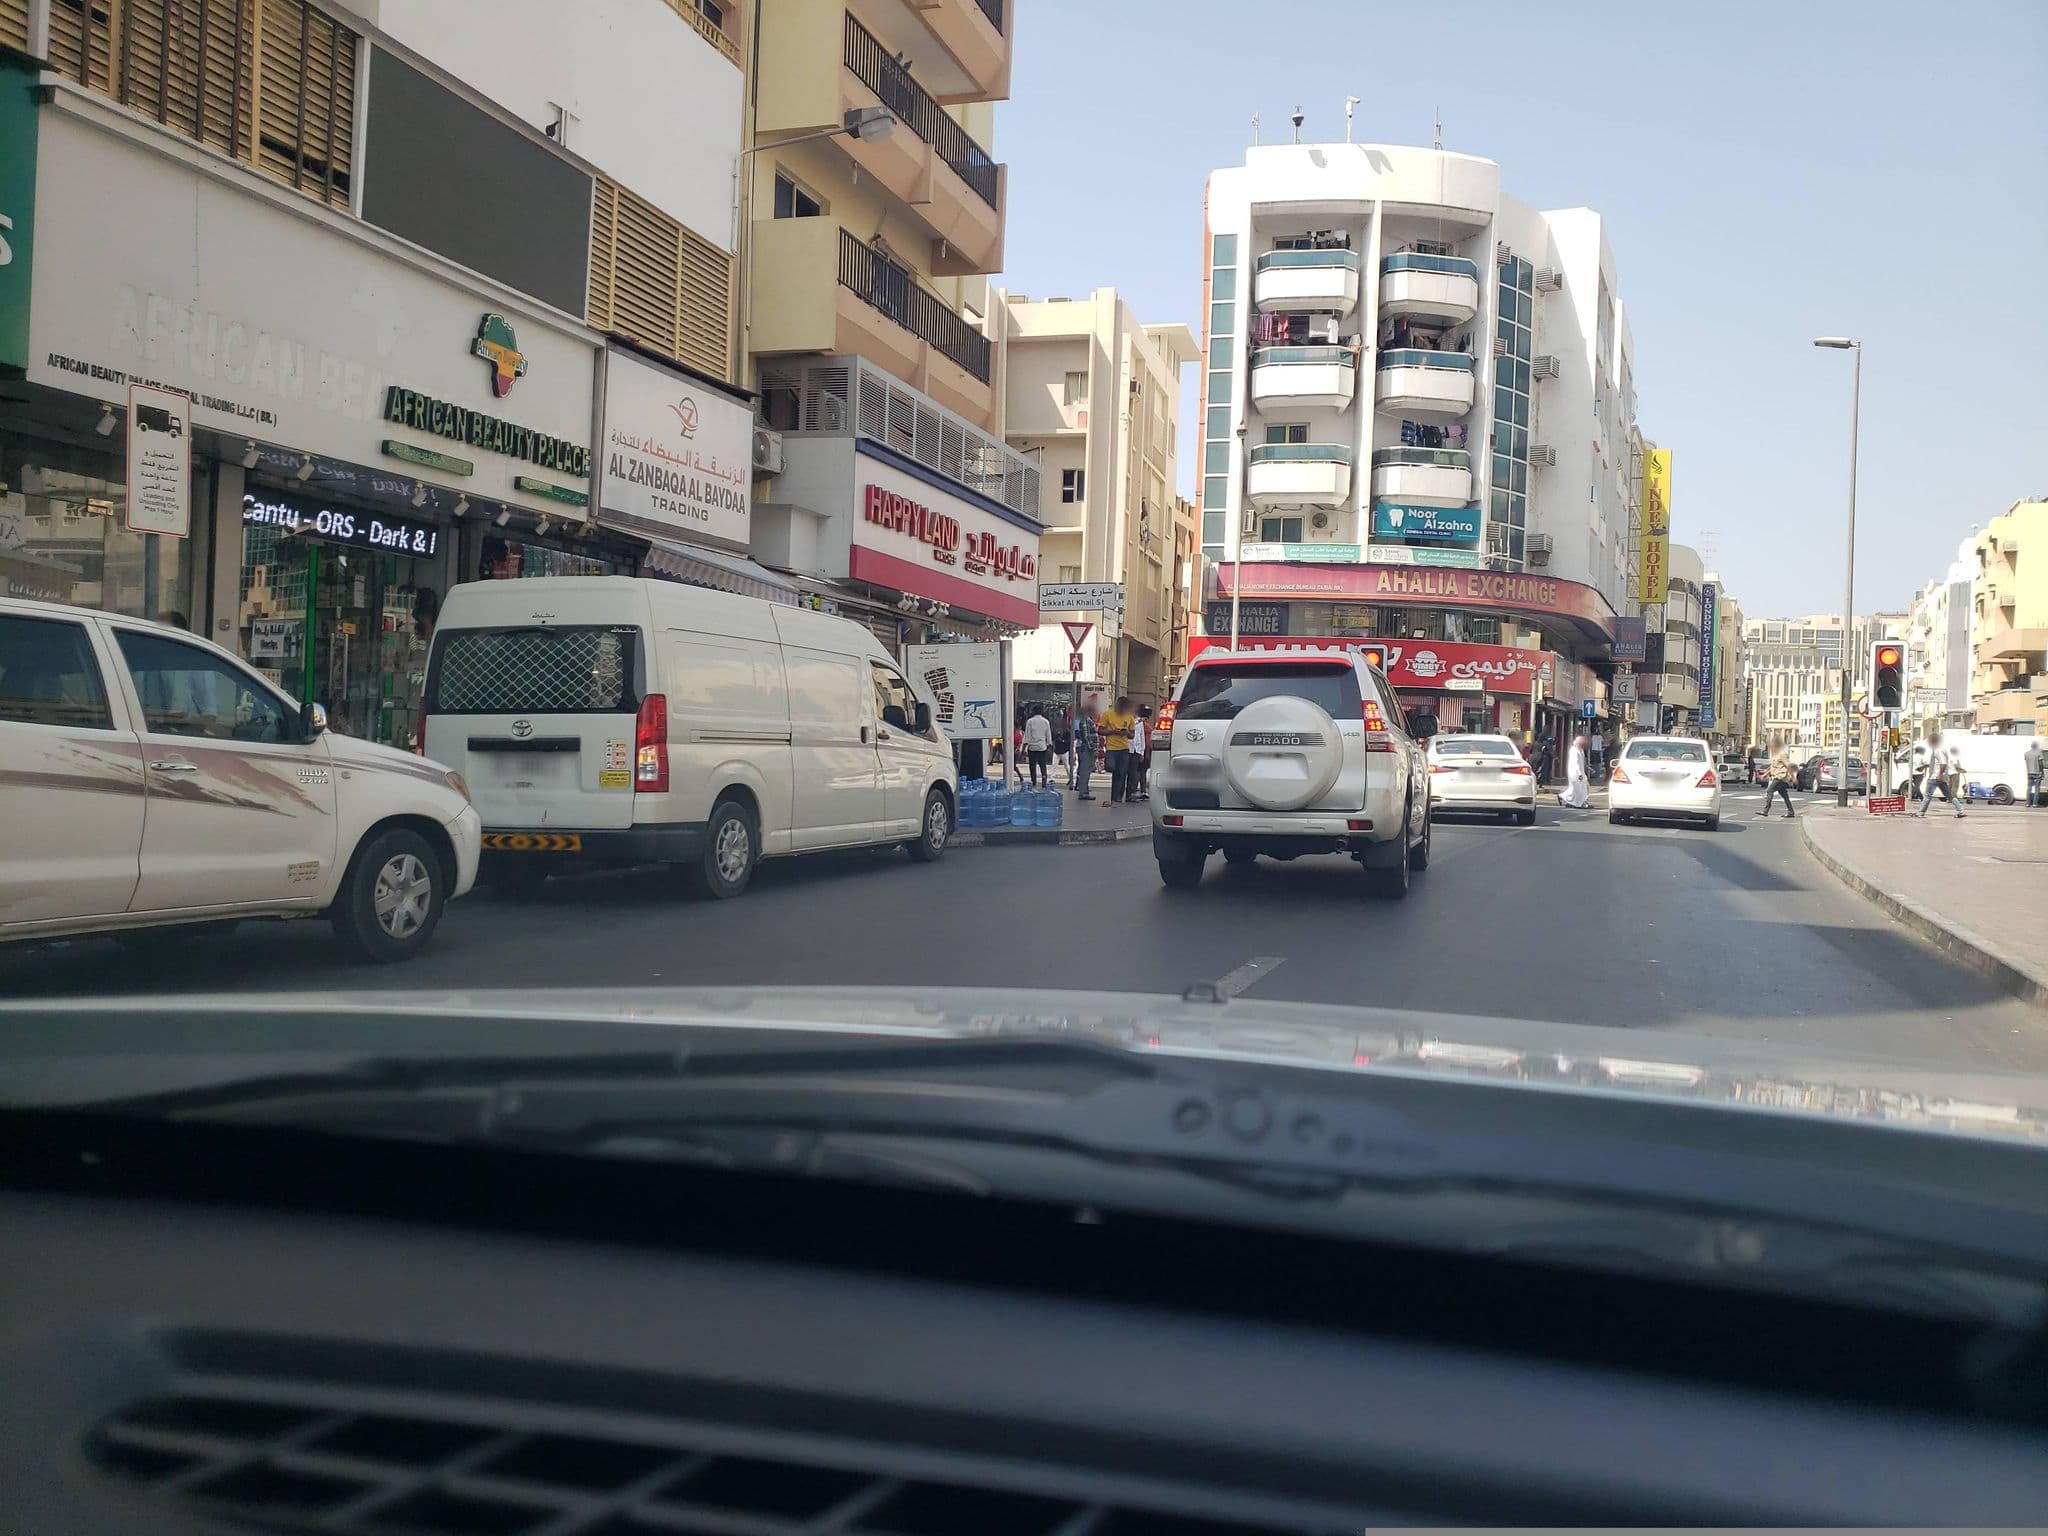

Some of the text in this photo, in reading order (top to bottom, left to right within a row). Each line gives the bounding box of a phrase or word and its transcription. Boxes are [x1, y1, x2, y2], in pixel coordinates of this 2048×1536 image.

[47, 353, 89, 376] AFRICAN
[91, 365, 126, 386] BEAUTY
[201, 394, 235, 414] TRADING
[385, 386, 591, 477] AFRICAN BEAUTY PALACE
[611, 428, 641, 450] للتجارة
[641, 437, 692, 468] البيضاء
[609, 452, 746, 514] AL ZANBAQA AL BAYDAA
[651, 494, 709, 521] TRADING
[865, 484, 961, 551] HAPPY LAND
[1408, 508, 1438, 519] Noor
[243, 494, 299, 529] Cantu
[316, 510, 355, 538] ORS
[369, 520, 410, 550] Dark
[412, 529, 427, 552] &
[1646, 541, 1661, 598] HOTEL
[1042, 587, 1066, 597] الخيل
[1091, 587, 1113, 597] شارع
[1376, 570, 1557, 604] AHALIA EXCHANGE
[1215, 607, 1229, 616] AL
[1703, 598, 1712, 631] LONDON
[1703, 633, 1711, 655] CITY
[1702, 657, 1710, 685] HOTEL
[1254, 737, 1300, 745] PRADO
